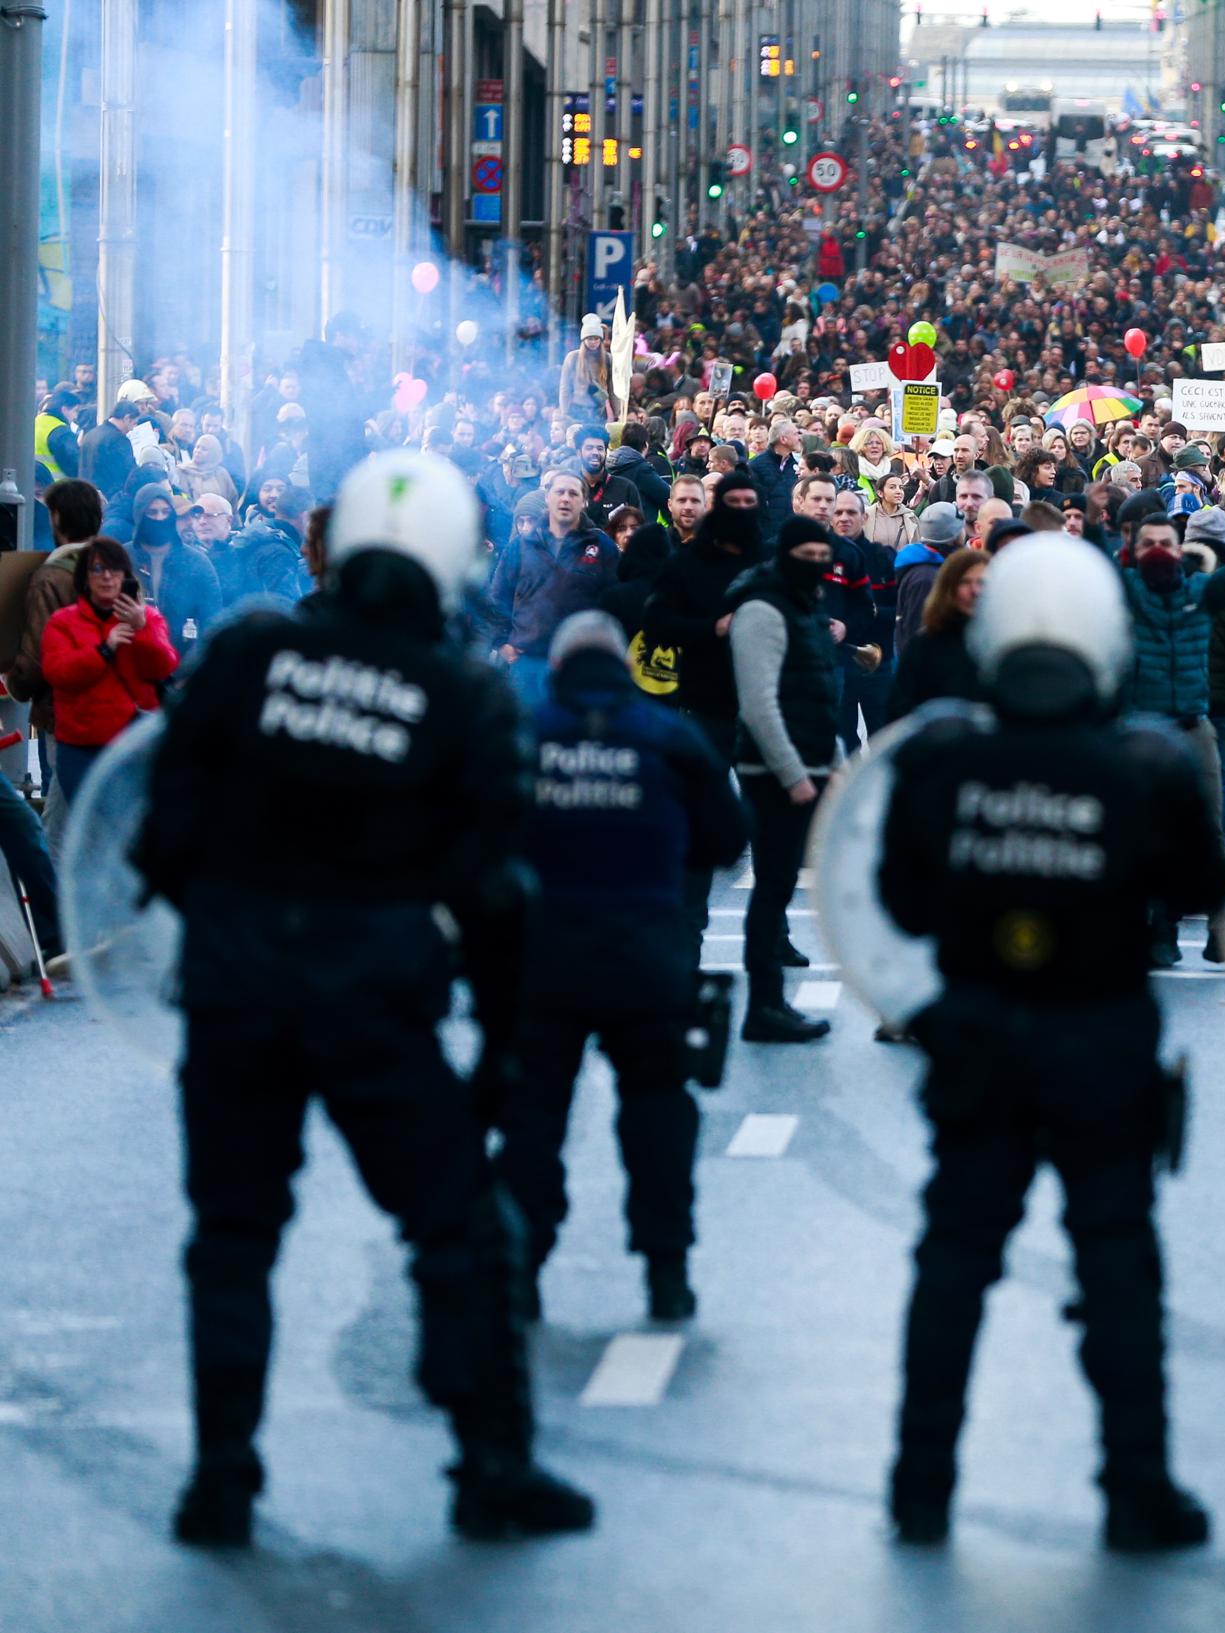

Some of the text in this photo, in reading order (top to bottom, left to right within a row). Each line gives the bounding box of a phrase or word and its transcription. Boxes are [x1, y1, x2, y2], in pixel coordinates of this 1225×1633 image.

[816, 163, 837, 177] 50
[594, 237, 625, 279] P
[853, 368, 885, 384] STOP
[907, 386, 937, 395] NOTICE
[1181, 385, 1203, 396] CECI
[1207, 387, 1224, 397] EST
[1182, 400, 1196, 408] UNE
[1182, 412, 1196, 420] ILS
[264, 649, 428, 724] Politie
[258, 692, 410, 765] Police
[539, 741, 639, 777] Police
[535, 776, 642, 810] Politie
[955, 780, 1104, 835] Police
[950, 828, 1106, 879] Politie
